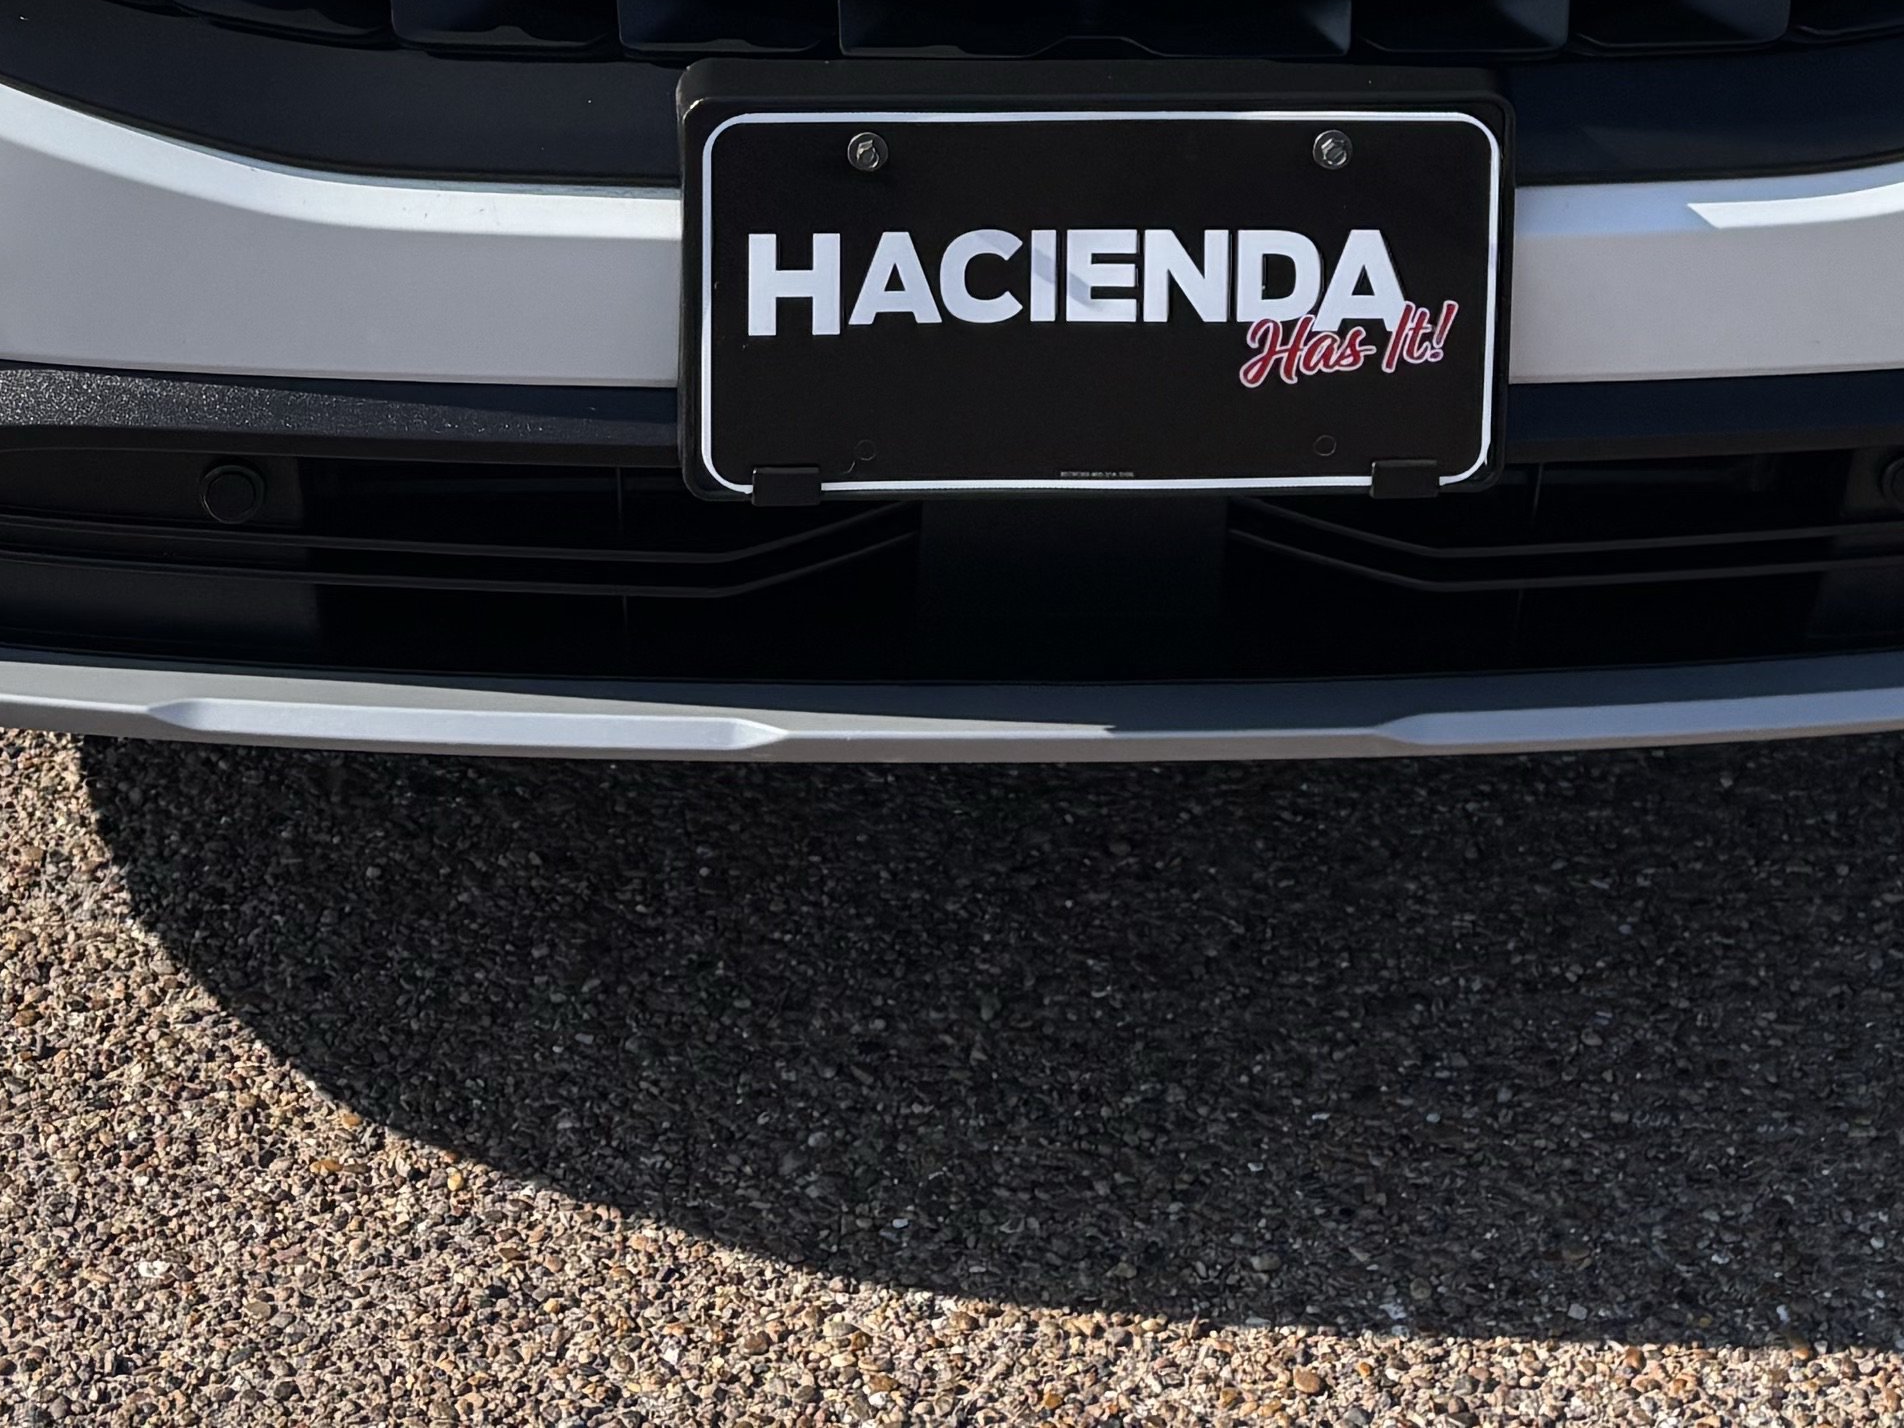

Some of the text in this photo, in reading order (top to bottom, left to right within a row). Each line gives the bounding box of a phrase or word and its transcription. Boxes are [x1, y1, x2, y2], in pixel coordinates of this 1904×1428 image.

[747, 228, 1406, 336] HACIENDA
[1240, 300, 1458, 387] Has It!
